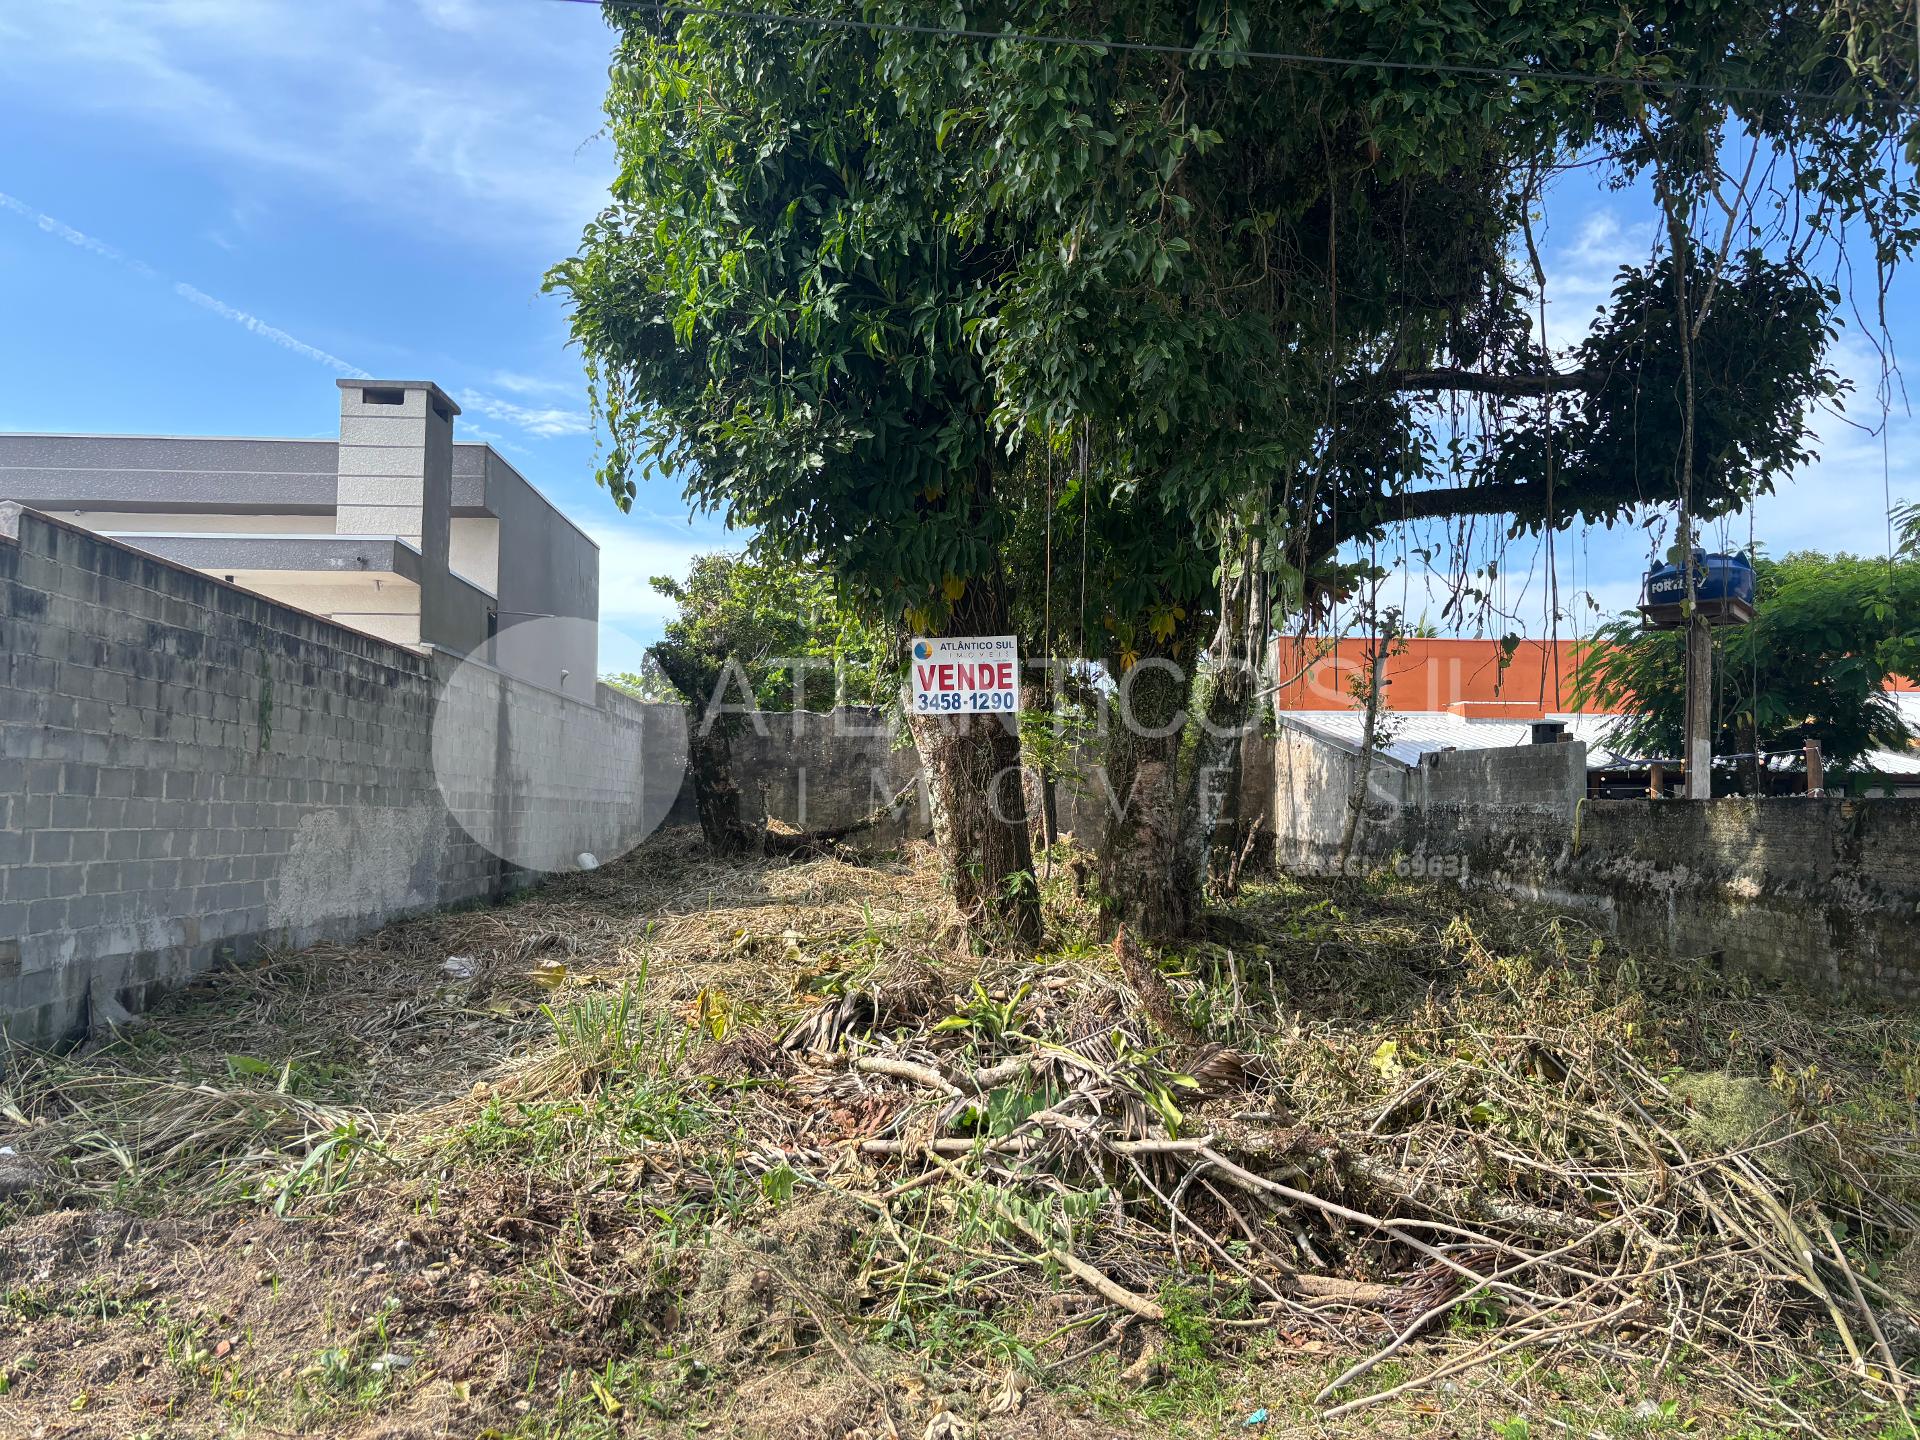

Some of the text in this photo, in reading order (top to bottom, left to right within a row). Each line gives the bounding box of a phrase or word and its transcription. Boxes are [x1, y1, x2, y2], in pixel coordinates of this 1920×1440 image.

[940, 641, 1014, 651] ATLÂNTICO SUL
[917, 662, 1014, 692] VENDE
[918, 692, 1015, 711] 3458-1290
